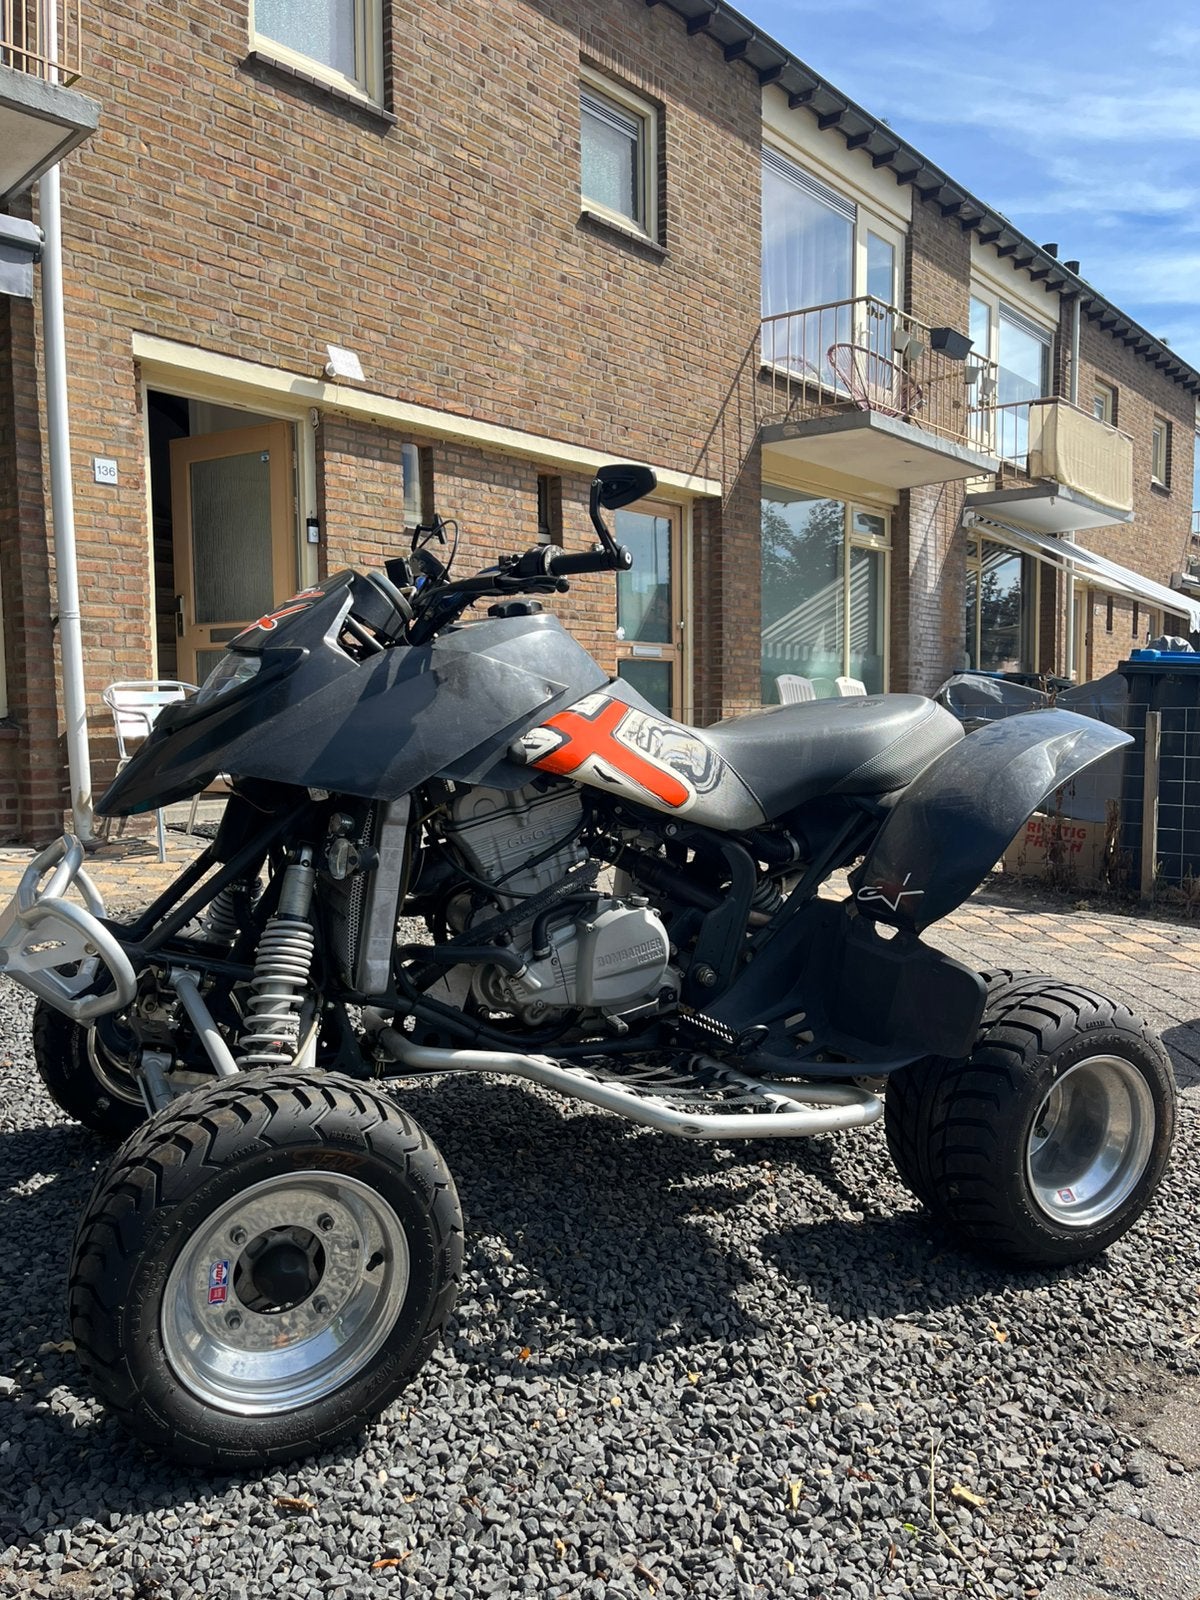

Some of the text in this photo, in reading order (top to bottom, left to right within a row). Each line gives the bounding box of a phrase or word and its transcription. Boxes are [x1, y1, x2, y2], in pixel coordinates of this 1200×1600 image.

[97, 465, 116, 477] 136
[1027, 821, 1087, 839] RITIG
[597, 937, 662, 967] BOMBARDIER
